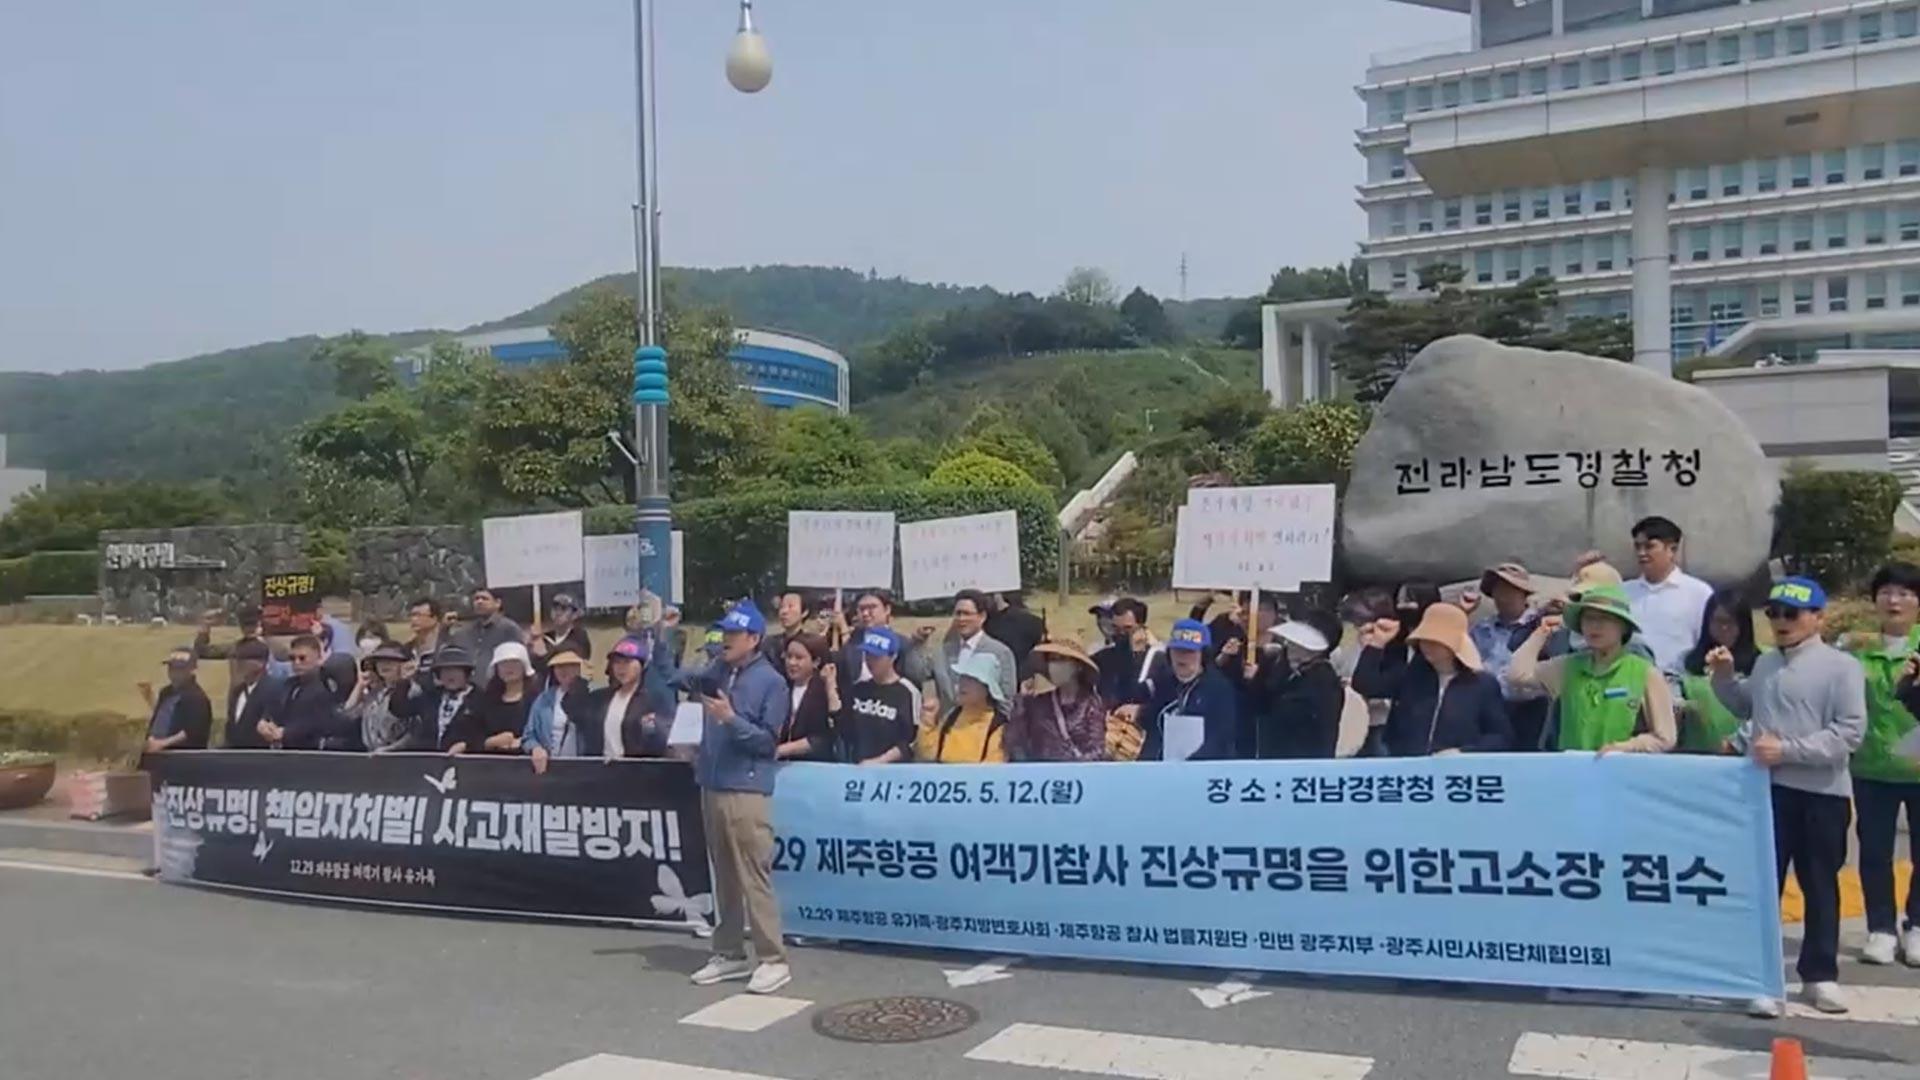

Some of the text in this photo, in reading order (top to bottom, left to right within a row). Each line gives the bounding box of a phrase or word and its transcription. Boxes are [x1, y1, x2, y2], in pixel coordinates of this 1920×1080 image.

[1395, 448, 1700, 495] 전라남도경찰청
[264, 575, 315, 597] 진상규명!
[844, 780, 866, 802] 일
[870, 780, 892, 803] 시
[908, 780, 972, 804] 2025.
[979, 780, 999, 804] 5.
[1207, 777, 1233, 804] 장
[1240, 778, 1266, 803] 소
[1291, 775, 1435, 804] 전남경찰청
[1445, 774, 1505, 804] 정문
[166, 786, 683, 862] 진상규명! 책임자처벌! 사고재발방지!
[290, 859, 314, 875] 12.29
[353, 862, 380, 881] 여객기
[382, 866, 402, 883] 참사
[404, 866, 436, 887] 유가족
[816, 837, 938, 880] 제주항공
[951, 842, 1129, 887] 여객기참사
[1140, 845, 1349, 892] 진상규명을
[1365, 848, 1605, 900] 위한고소장
[1622, 854, 1728, 906] 접수
[798, 906, 833, 921] 12.29
[836, 908, 888, 927] 제주항공
[1126, 926, 1159, 944] 참사
[1163, 927, 1248, 949] 법률지원단
[1300, 933, 1373, 955] 광주지부
